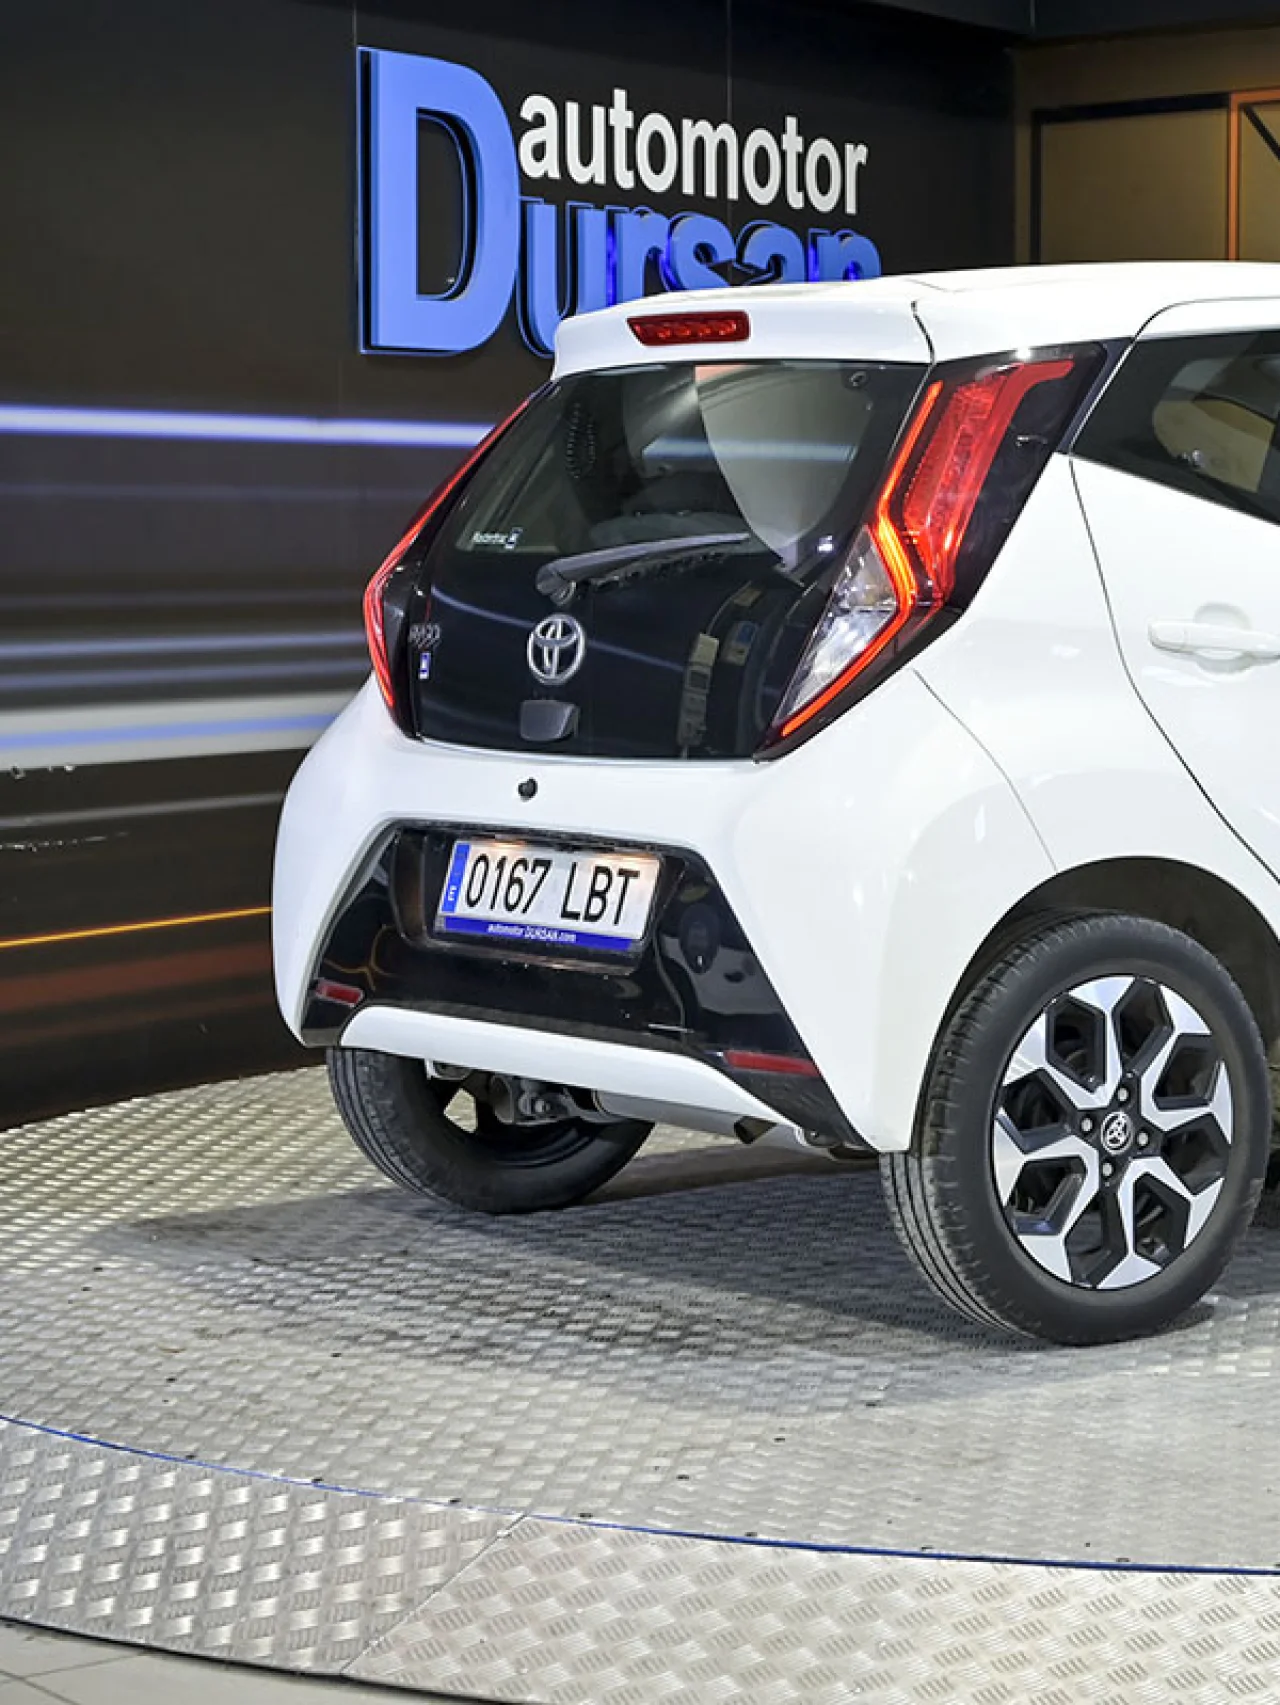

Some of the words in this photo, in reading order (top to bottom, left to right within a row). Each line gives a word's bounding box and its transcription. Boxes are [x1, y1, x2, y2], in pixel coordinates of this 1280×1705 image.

[519, 88, 868, 215] automotor
[447, 885, 456, 902] E
[466, 853, 552, 914] 0167
[560, 861, 641, 926] LBT
